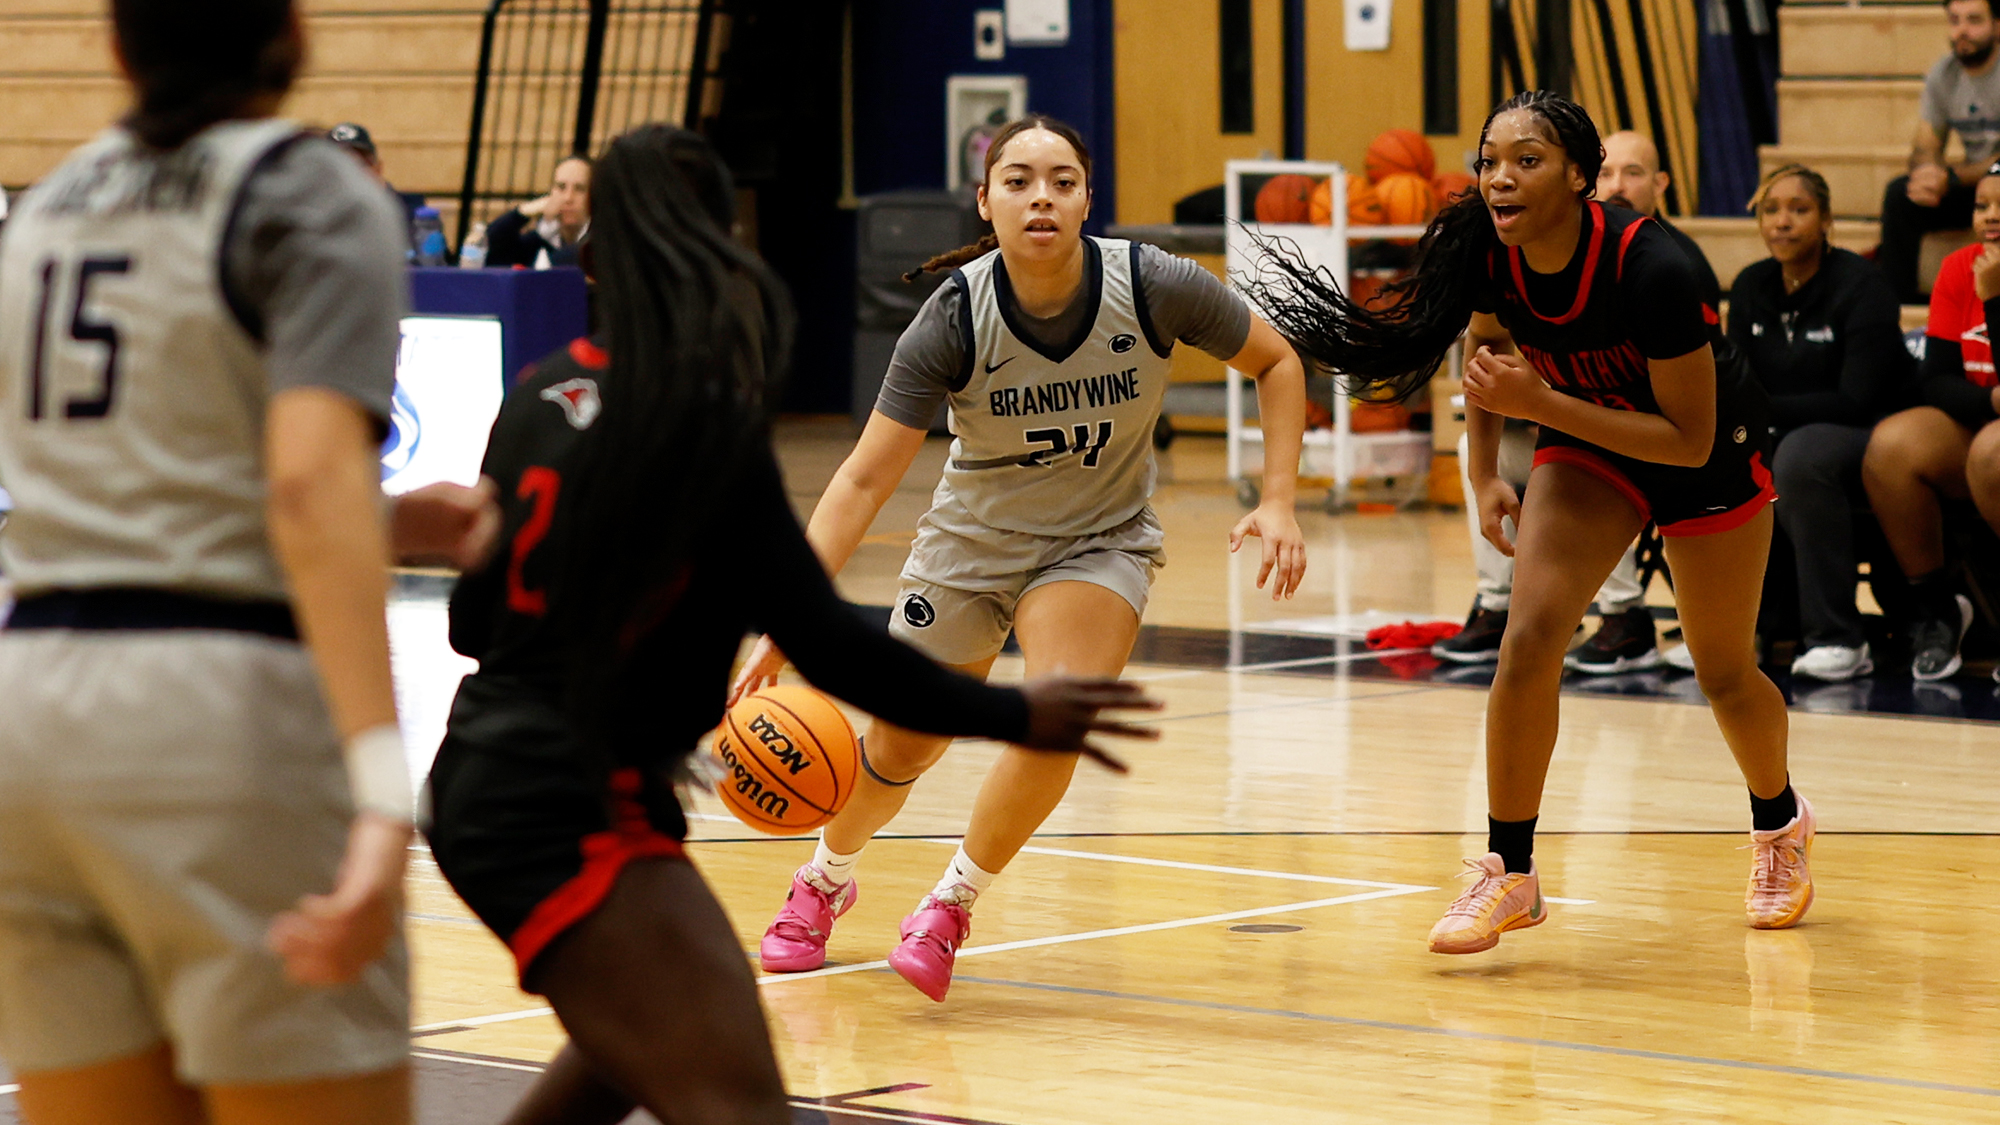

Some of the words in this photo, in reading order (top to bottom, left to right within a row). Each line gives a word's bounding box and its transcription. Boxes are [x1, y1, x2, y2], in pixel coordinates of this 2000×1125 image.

[28, 258, 131, 421] 15
[990, 367, 1140, 417] BRANDYWINE
[1019, 419, 1114, 469] 24
[748, 713, 811, 776] NCAA
[718, 734, 789, 819] Wilson
